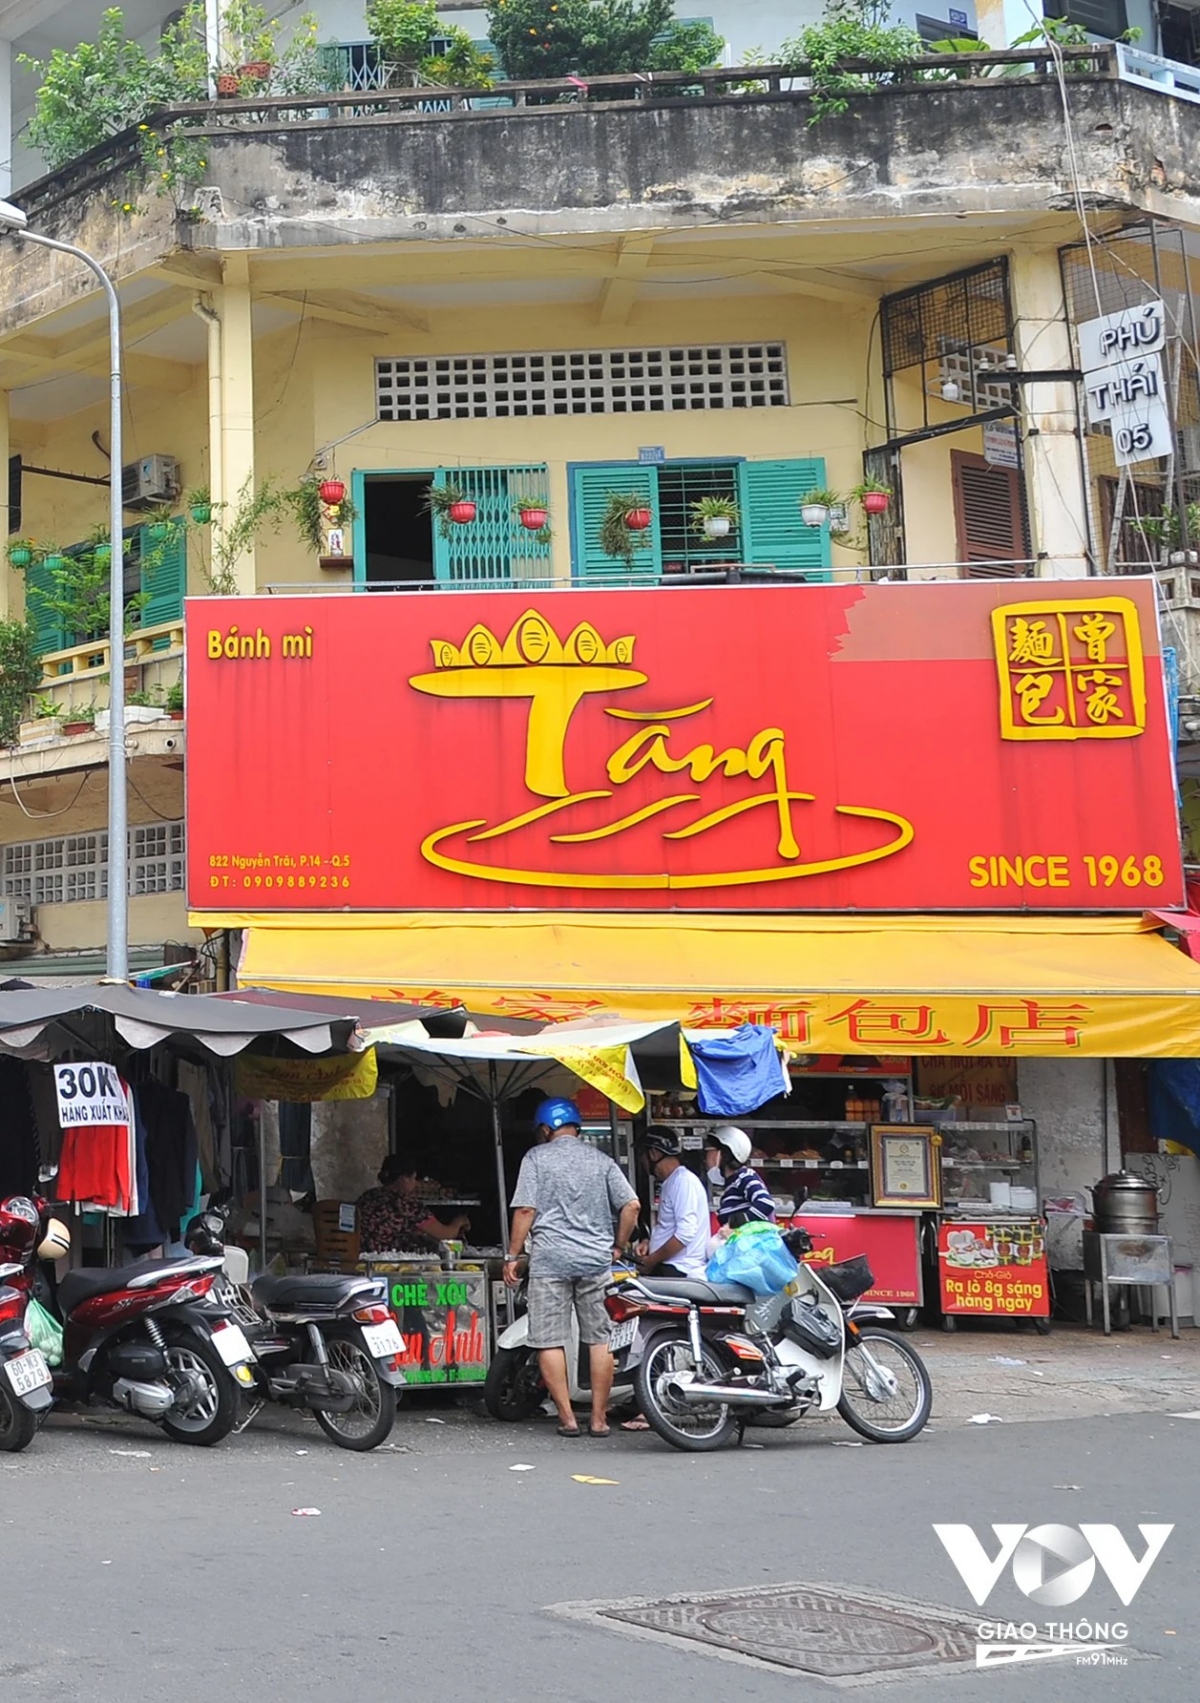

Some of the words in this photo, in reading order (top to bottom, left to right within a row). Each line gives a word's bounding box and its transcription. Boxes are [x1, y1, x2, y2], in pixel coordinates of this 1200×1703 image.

[1100, 307, 1160, 355] PHÚ
[1088, 363, 1158, 410] THÁI
[1116, 423, 1152, 454] 05
[208, 625, 271, 659] Bánh
[283, 625, 313, 659] mì
[209, 855, 228, 867] 822
[232, 852, 271, 870] Nguyễn
[300, 855, 321, 867] P.14
[969, 855, 1070, 888] SINCE
[1083, 855, 1165, 888] 1968
[244, 876, 350, 888] 0909889236
[61, 1101, 88, 1122] HÀNG
[392, 1277, 429, 1307] CHÈ
[436, 1276, 467, 1306] XÔI
[946, 1279, 964, 1293] Ra
[967, 1279, 981, 1294] lò
[985, 1280, 1003, 1298] 8g
[1007, 1280, 1043, 1299] sáng
[956, 1293, 993, 1312] hàng
[997, 1295, 1033, 1312] ngày
[428, 1309, 483, 1367] Anh
[16, 1368, 45, 1392] 5879
